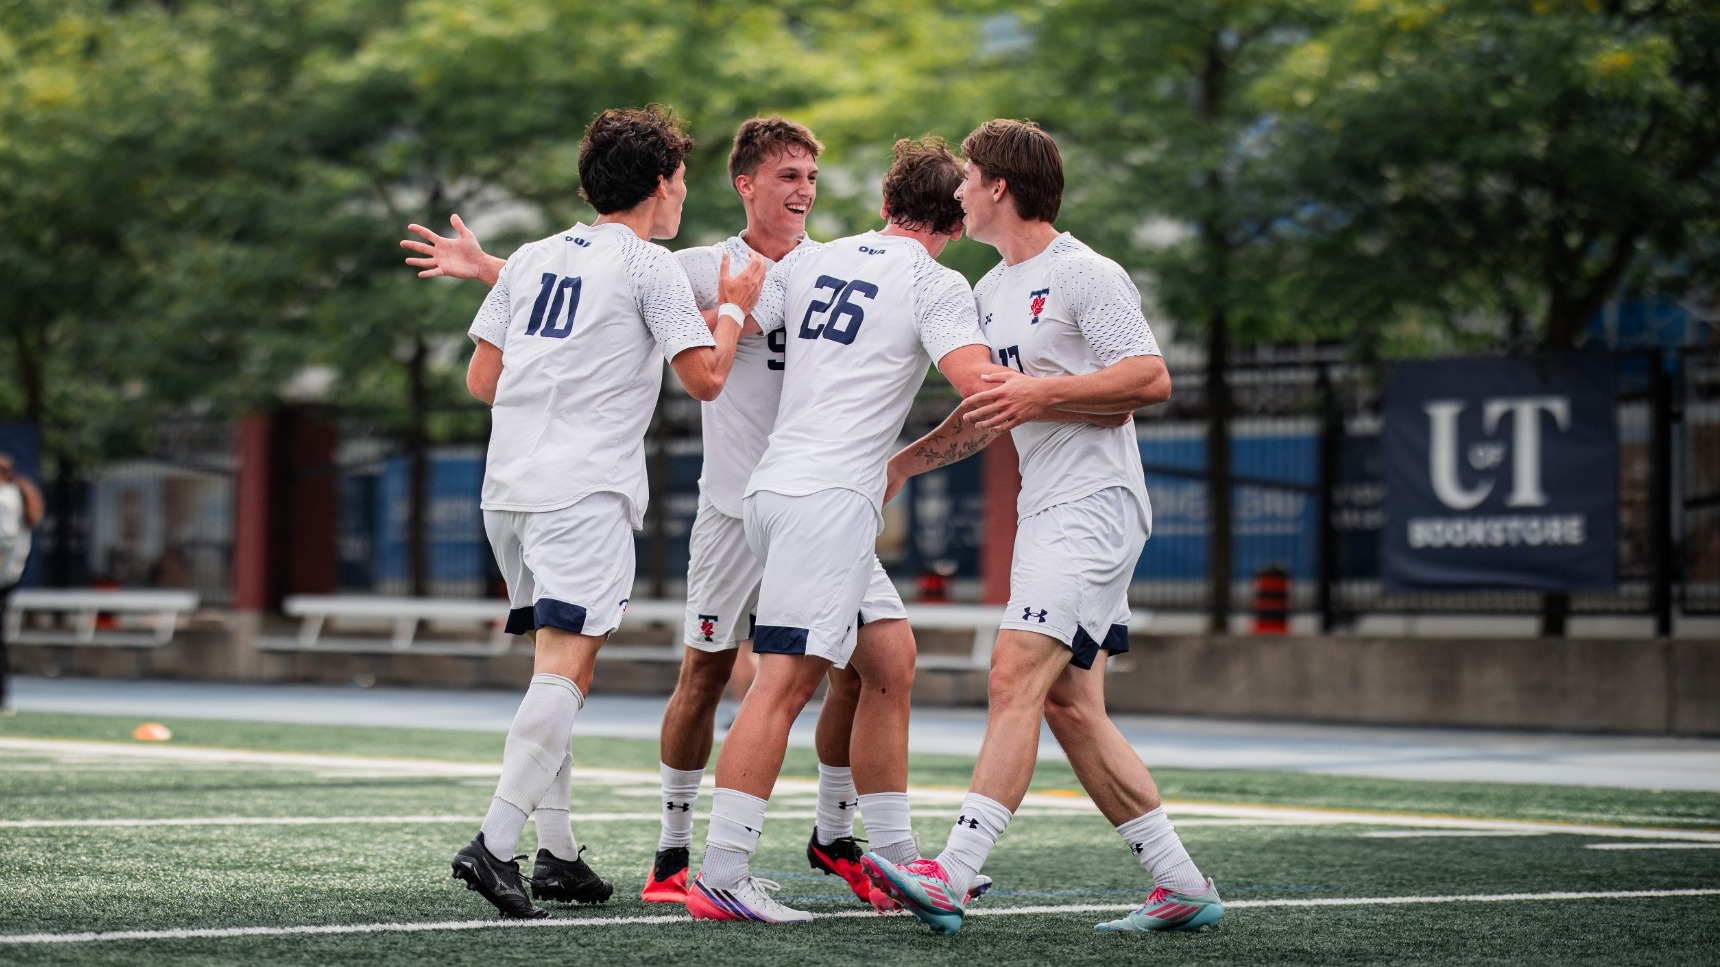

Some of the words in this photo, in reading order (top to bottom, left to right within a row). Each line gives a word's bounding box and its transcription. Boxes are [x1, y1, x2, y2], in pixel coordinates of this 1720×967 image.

[858, 245, 887, 256] OUA
[524, 272, 582, 339] 10
[798, 274, 879, 345] 26
[767, 326, 786, 371] 9
[1407, 515, 1587, 548] BOOKSTORE
